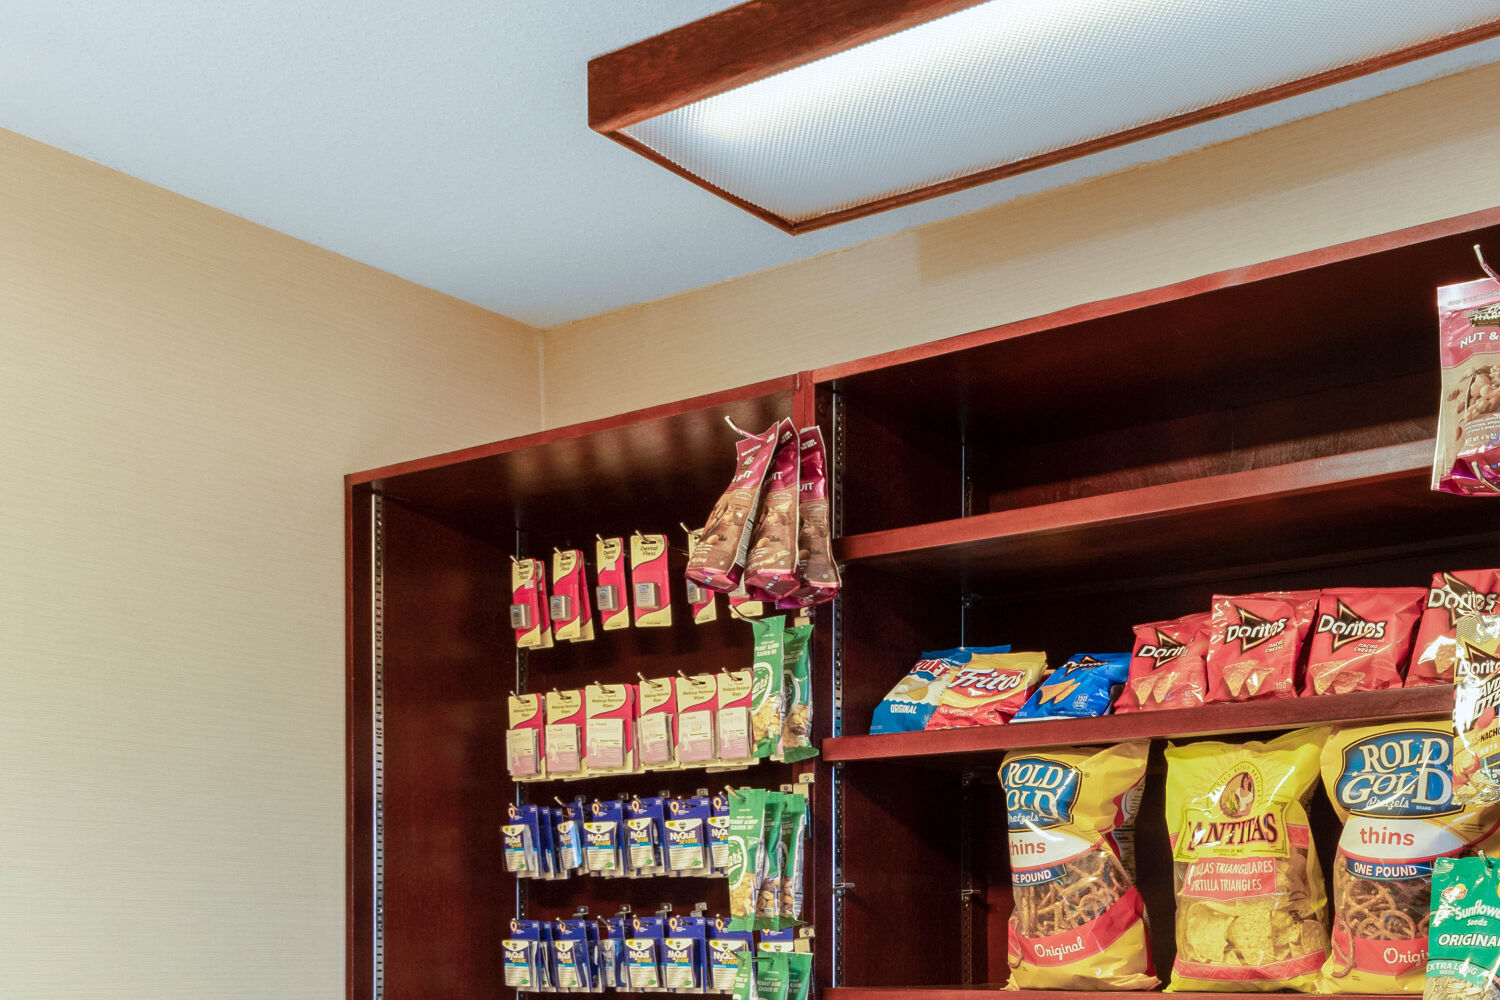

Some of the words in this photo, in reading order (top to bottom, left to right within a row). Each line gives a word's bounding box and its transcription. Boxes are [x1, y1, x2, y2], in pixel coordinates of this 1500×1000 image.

[1460, 332, 1485, 348] NUT
[1489, 331, 1499, 340] &
[1428, 589, 1498, 610] Doritos
[1226, 618, 1287, 643] Doritos
[1317, 615, 1385, 637] Doritos
[947, 669, 1025, 691] Fritos
[890, 704, 917, 714] ORIGINAL
[1362, 738, 1450, 772] ROLD
[1005, 763, 1063, 789] ROLD
[1342, 767, 1453, 805] GOLD
[1006, 789, 1059, 820] OLD
[670, 830, 696, 842] NyQuil
[1360, 827, 1414, 847] thins
[1021, 870, 1051, 883] POUND
[1353, 862, 1378, 877] ONE
[1379, 864, 1418, 877] POUND
[1221, 879, 1262, 891] TRIANGLES
[668, 950, 687, 960] NyQuil
[1034, 935, 1085, 962] Original
[1427, 962, 1453, 973] EXTRA
